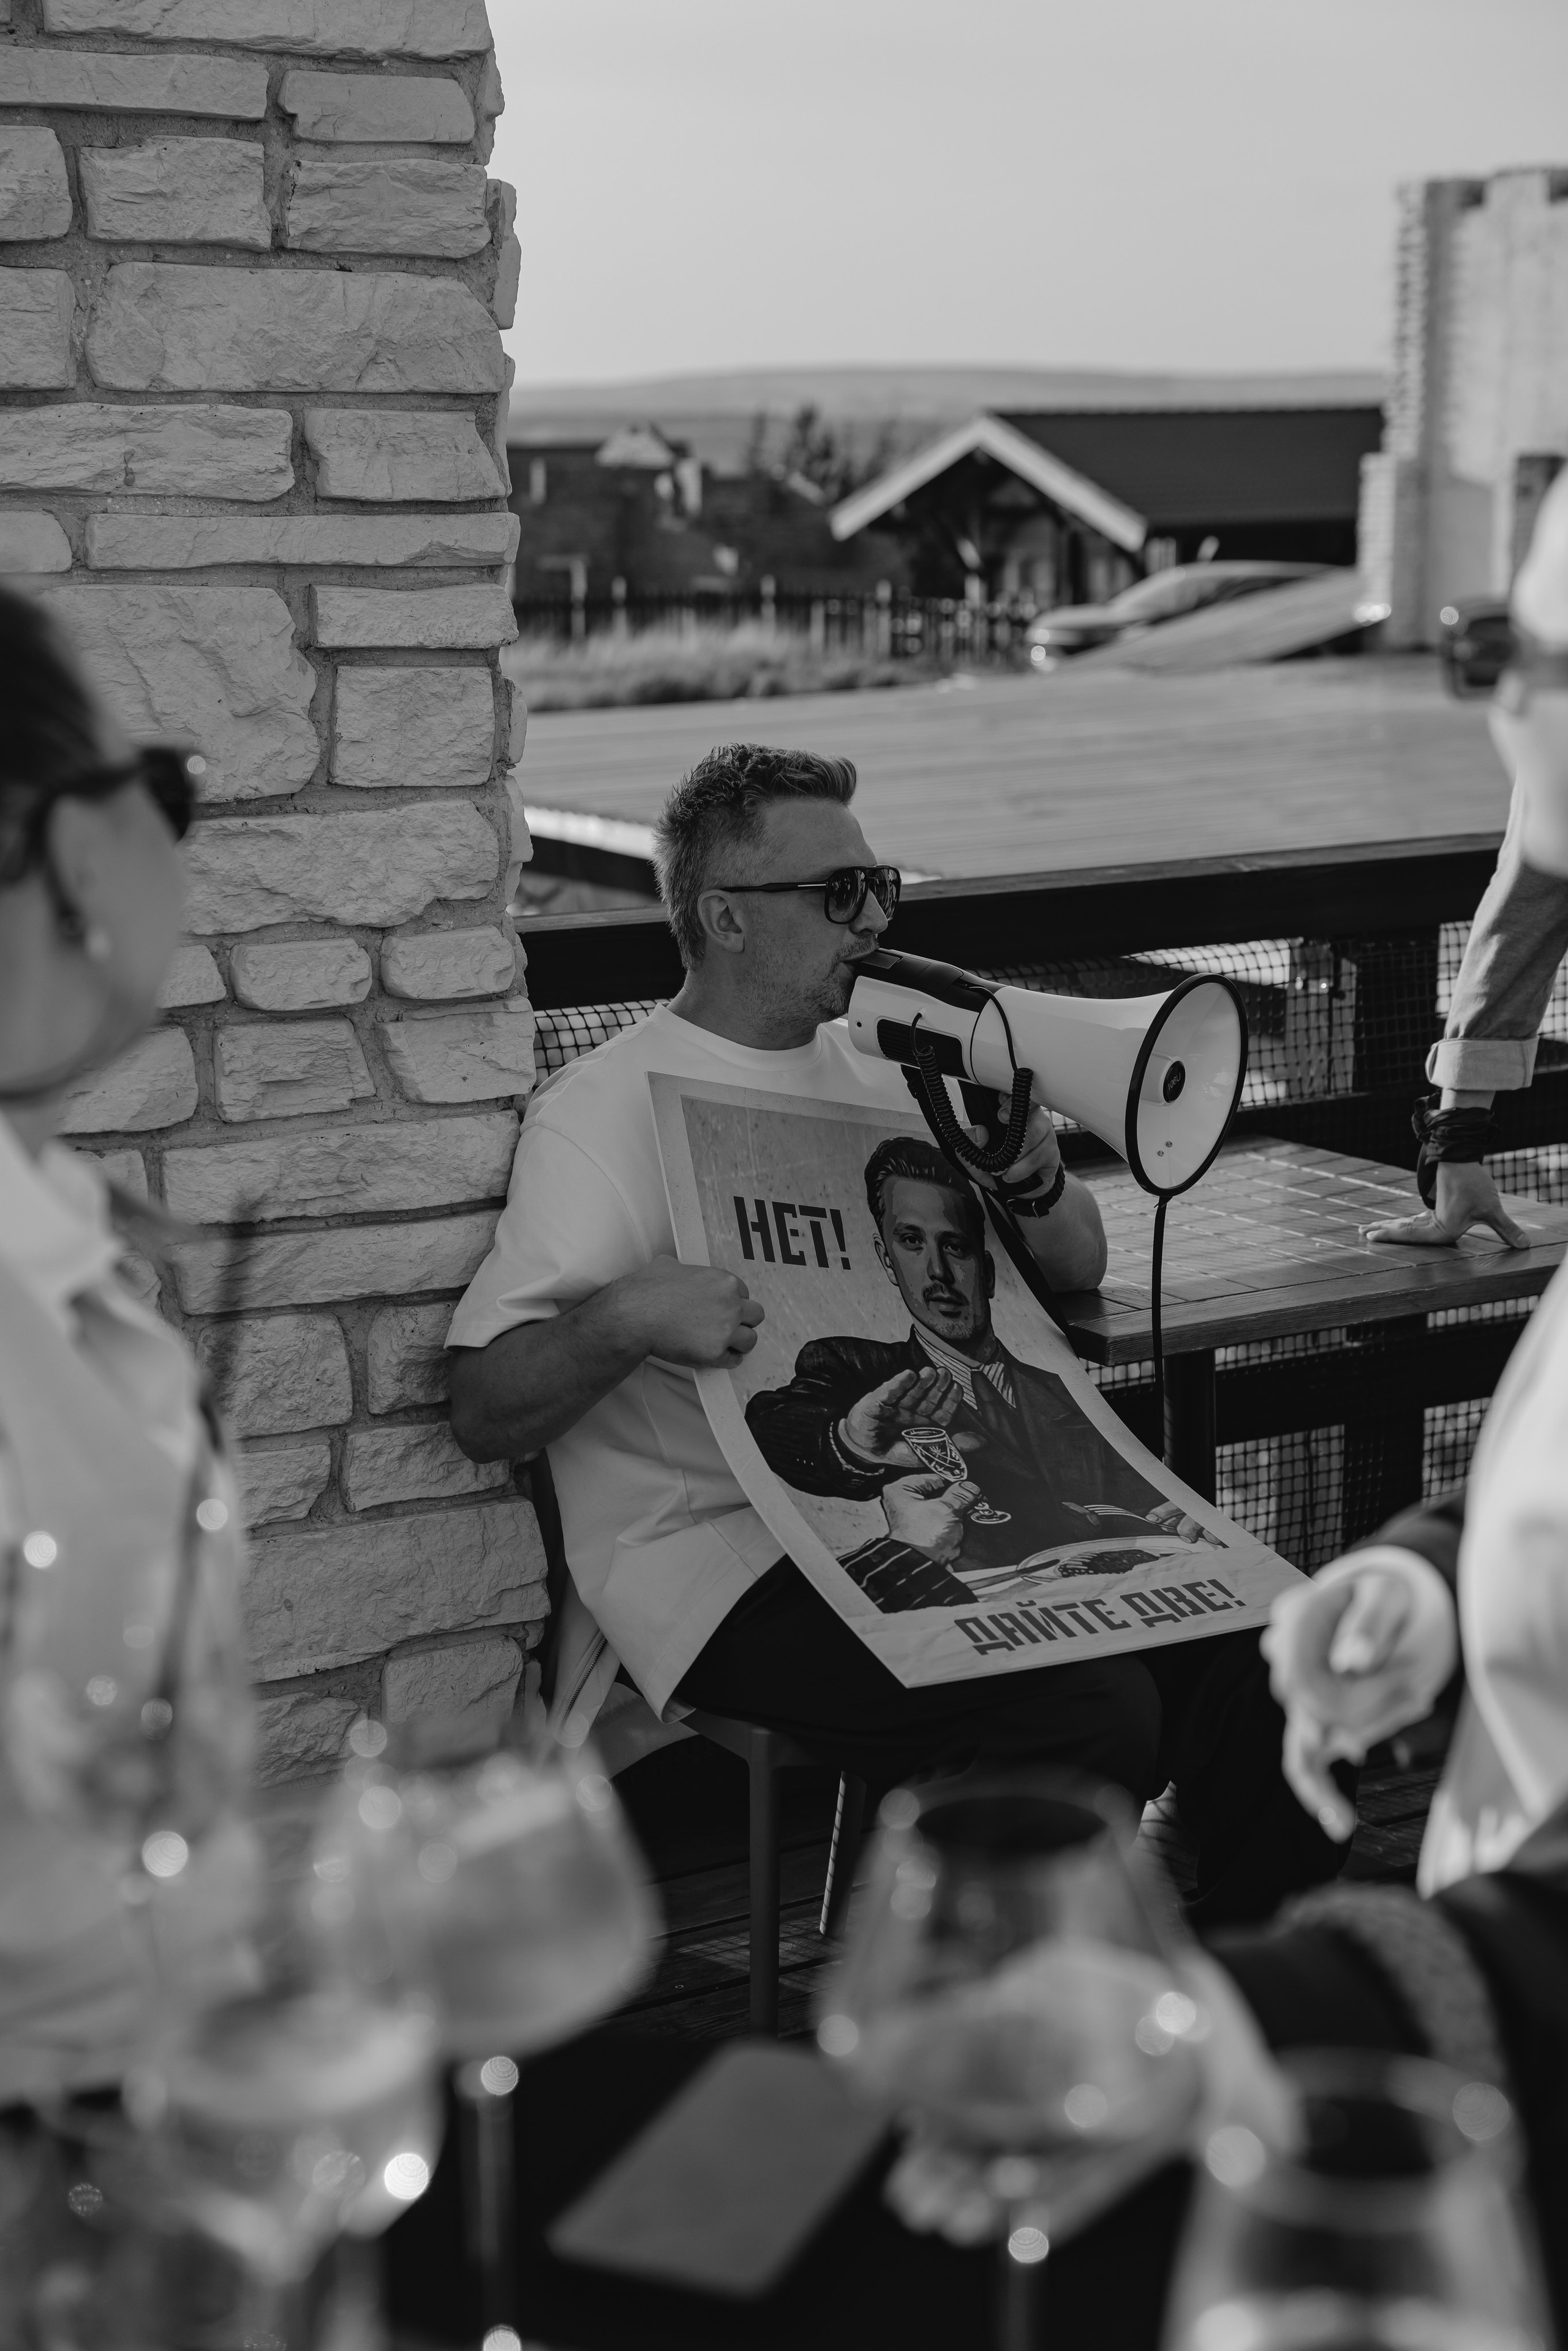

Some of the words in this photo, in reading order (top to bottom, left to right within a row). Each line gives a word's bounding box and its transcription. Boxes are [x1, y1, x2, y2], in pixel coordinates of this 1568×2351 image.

[1167, 1072, 1181, 1091] 106U
[733, 1196, 851, 1270] НЕТ!
[954, 1599, 1132, 1656] ДАЙТЕ
[1120, 1579, 1247, 1628] ДВЕ!
